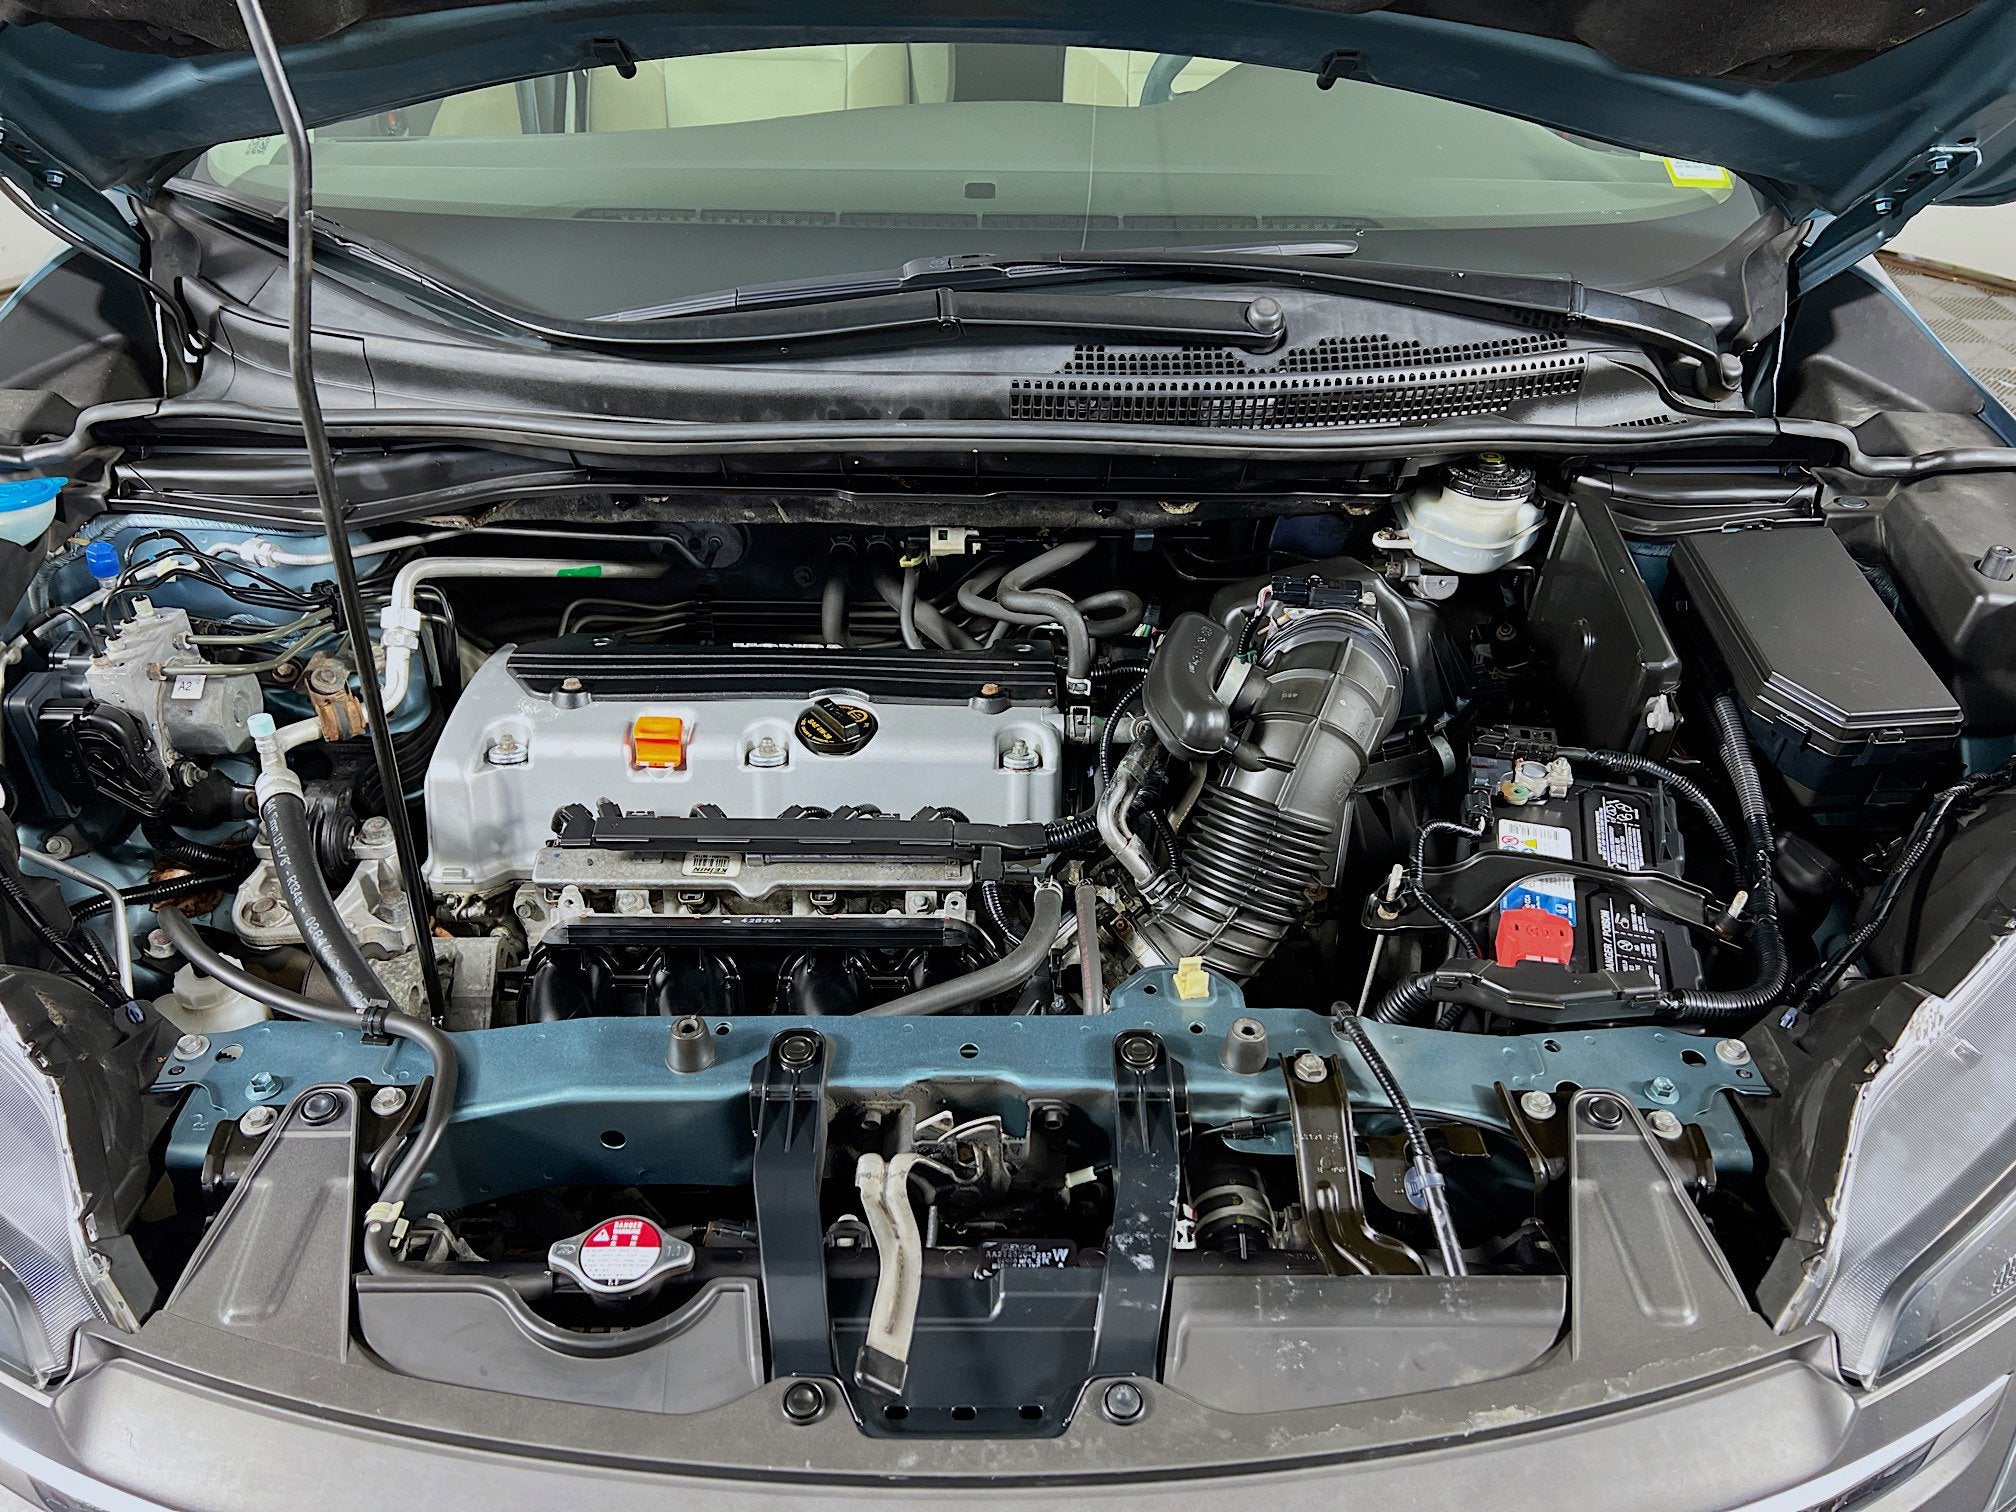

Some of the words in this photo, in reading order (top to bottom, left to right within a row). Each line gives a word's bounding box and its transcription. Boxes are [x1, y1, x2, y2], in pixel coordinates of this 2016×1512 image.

[178, 681, 192, 691] A2
[287, 874, 303, 907] R134a
[1600, 909, 1612, 937] POISON
[614, 1221, 643, 1229] DANGER
[1052, 1248, 1069, 1262] W
